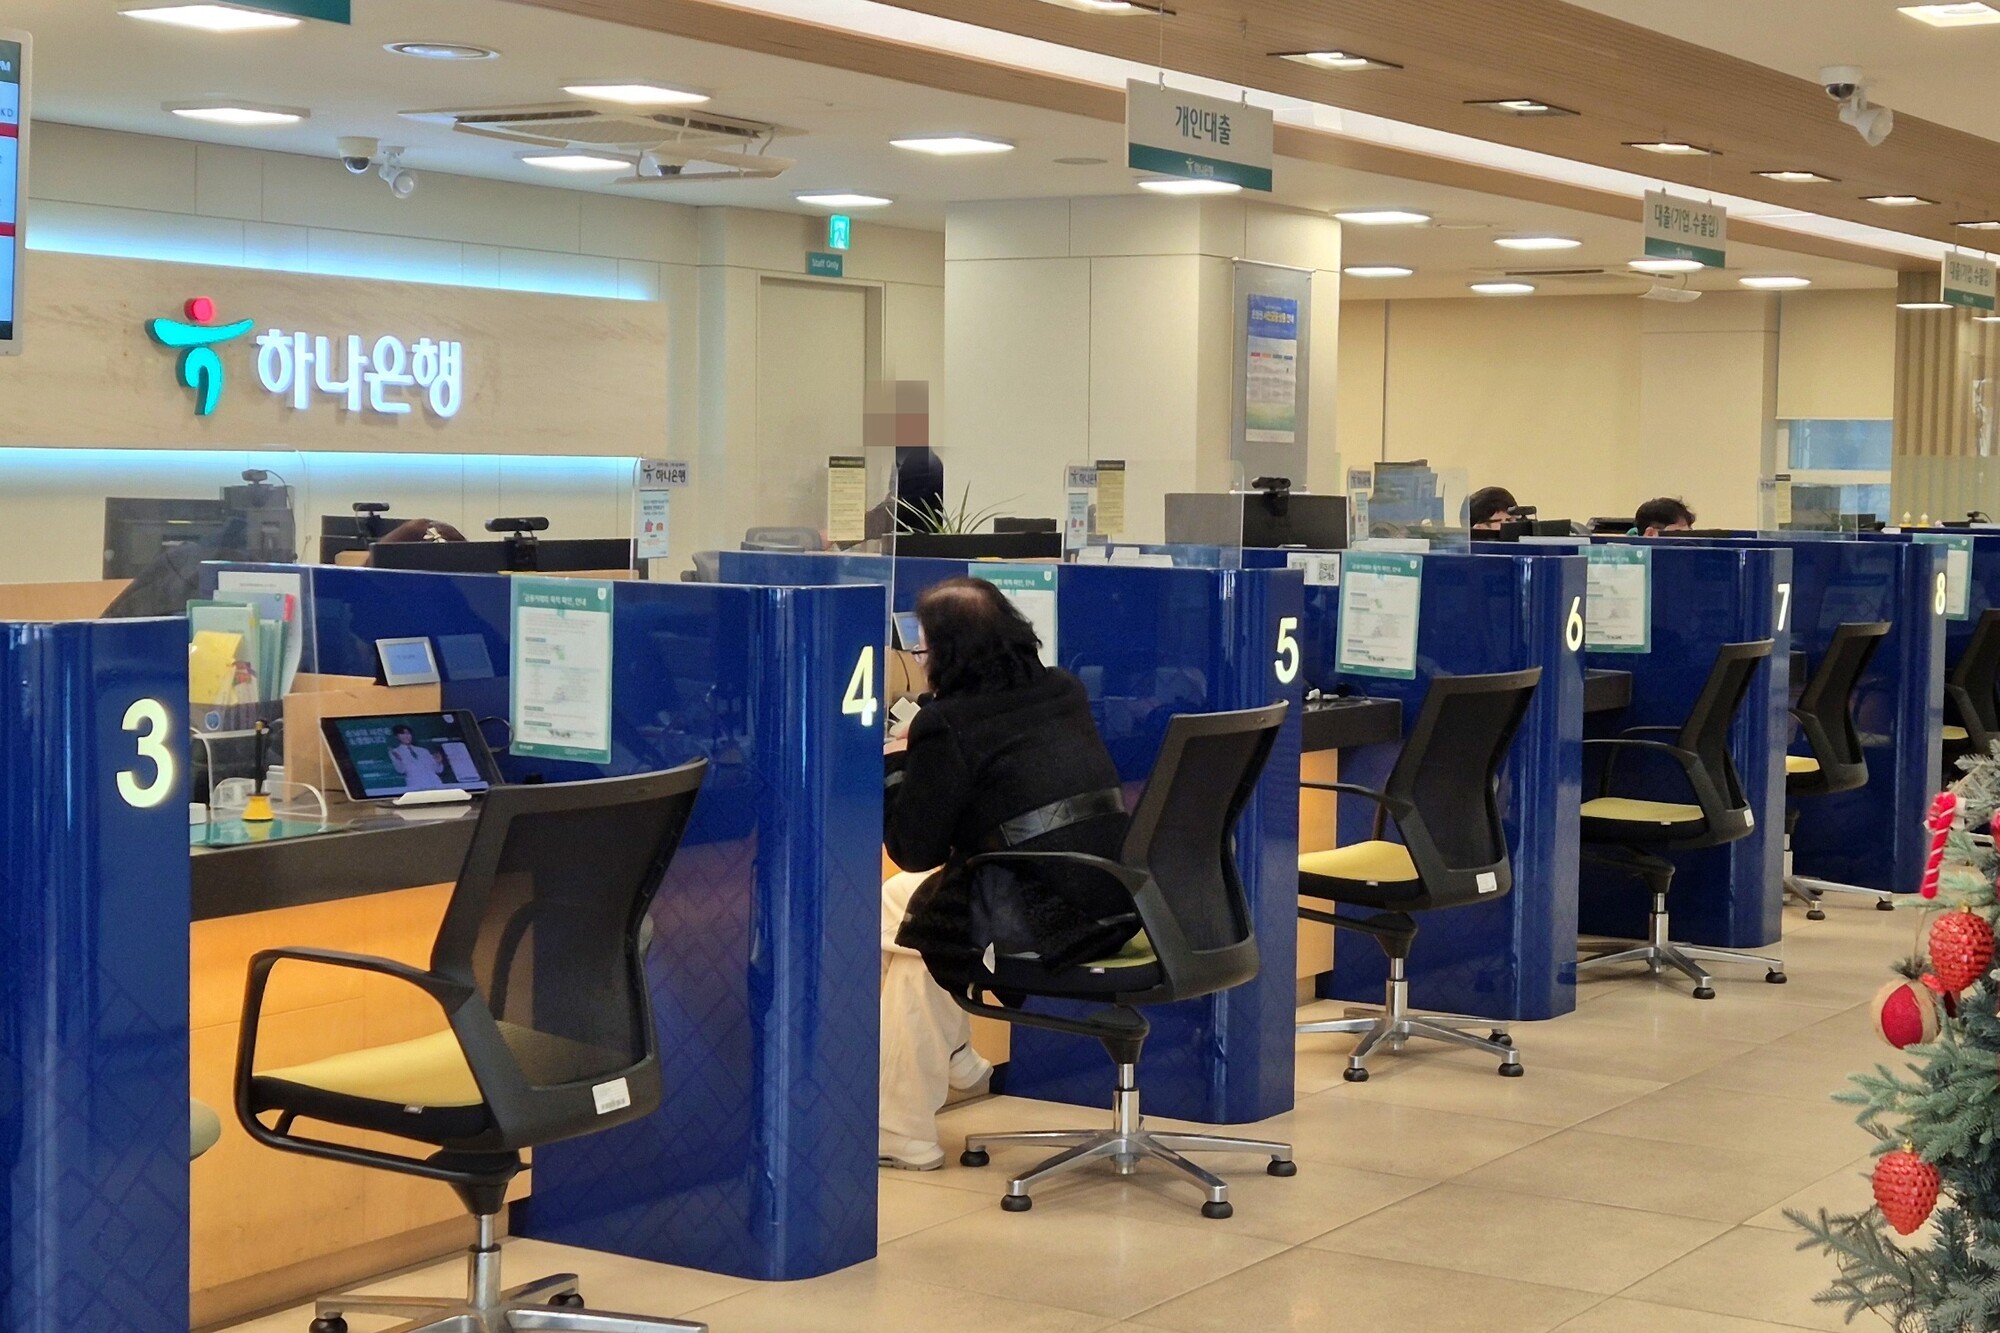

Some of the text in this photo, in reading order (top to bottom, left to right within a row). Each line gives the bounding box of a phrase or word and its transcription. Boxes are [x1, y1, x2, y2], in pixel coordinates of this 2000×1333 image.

[1175, 105, 1231, 146] 개인대출
[256, 328, 463, 418] 하나은행
[656, 469, 686, 483] 하나은행
[1777, 582, 1790, 632] 7
[1935, 572, 1946, 615] 8
[1274, 616, 1300, 684] 5
[1565, 595, 1584, 652] 6
[841, 645, 878, 727] 4
[116, 697, 174, 809] 3
